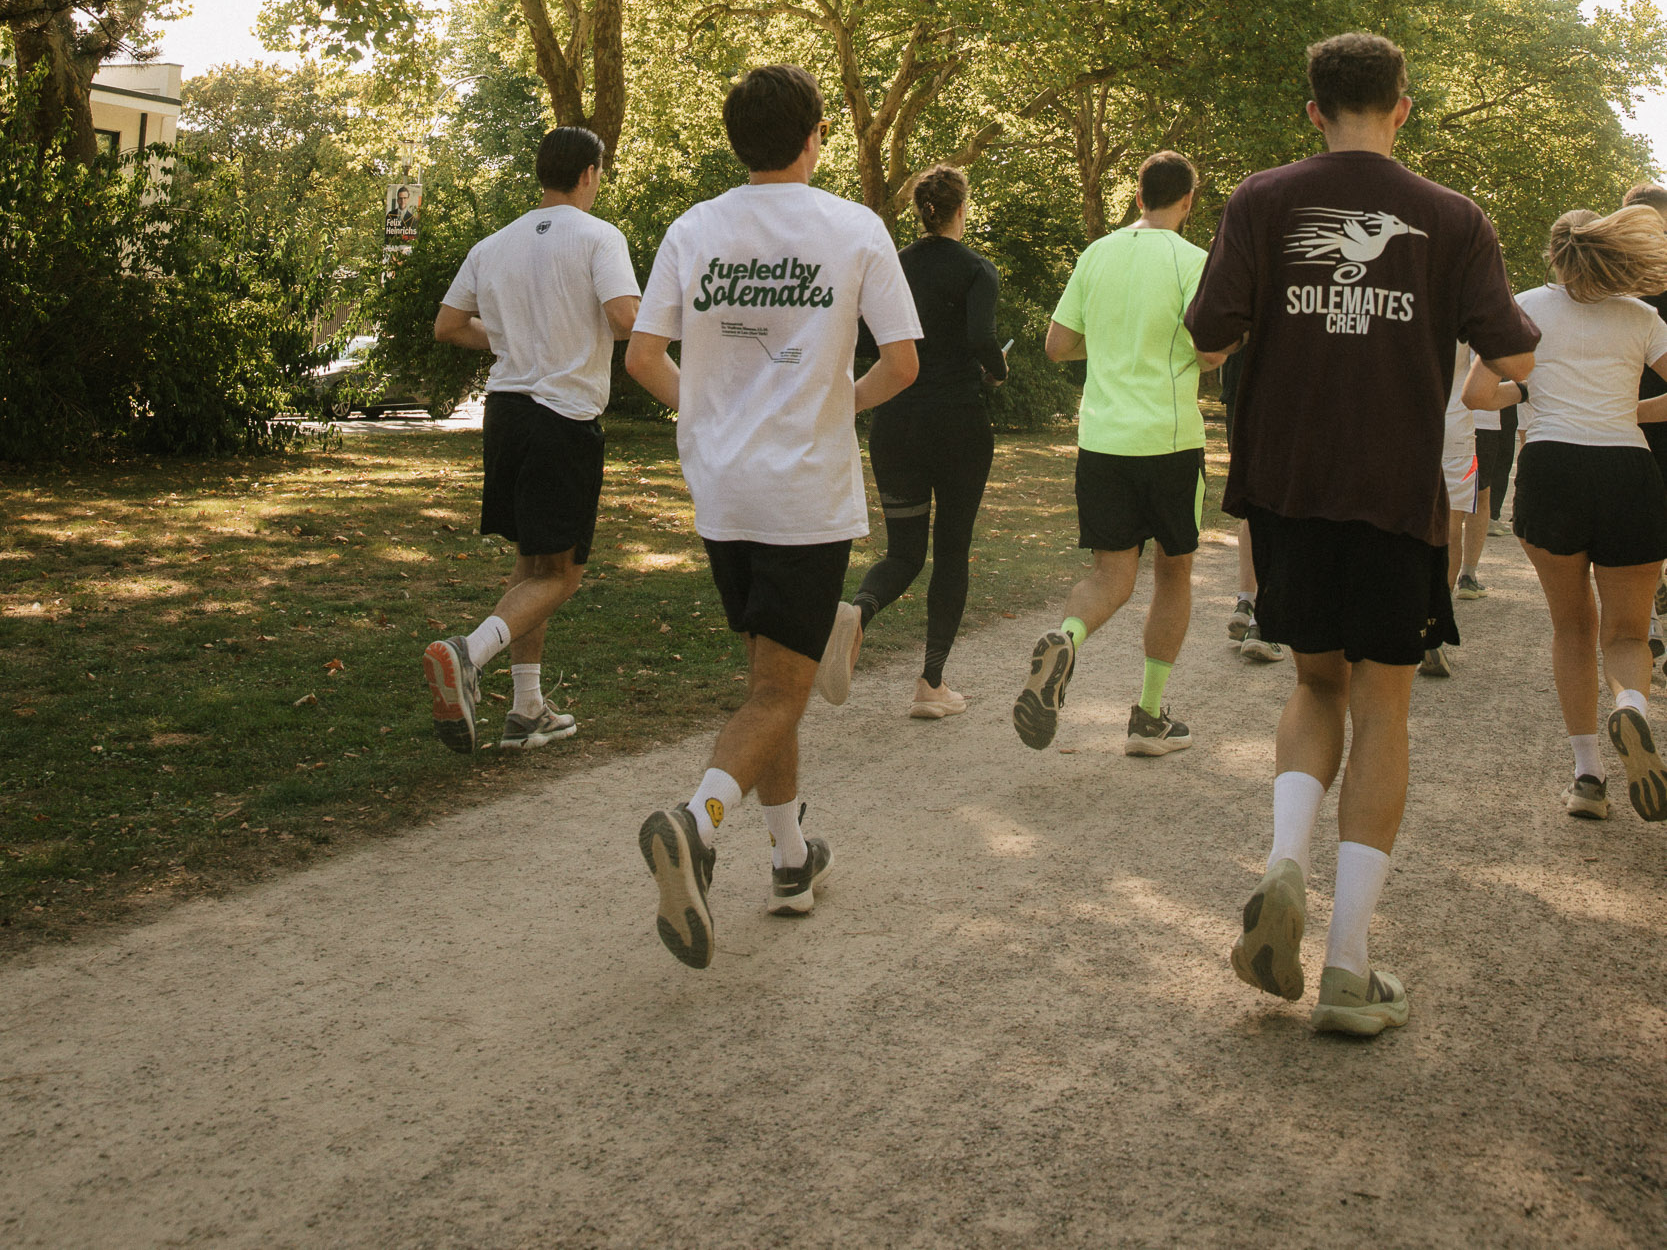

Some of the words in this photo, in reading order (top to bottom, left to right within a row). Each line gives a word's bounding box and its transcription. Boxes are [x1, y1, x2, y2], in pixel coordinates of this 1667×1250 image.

[385, 226, 417, 235] Heinrichs
[386, 218, 402, 227] Felix
[708, 257, 789, 281] fueled
[789, 257, 822, 284] by
[693, 273, 834, 312] Solemates
[1286, 285, 1415, 322] SOLEMATES
[1326, 313, 1370, 335] CREW
